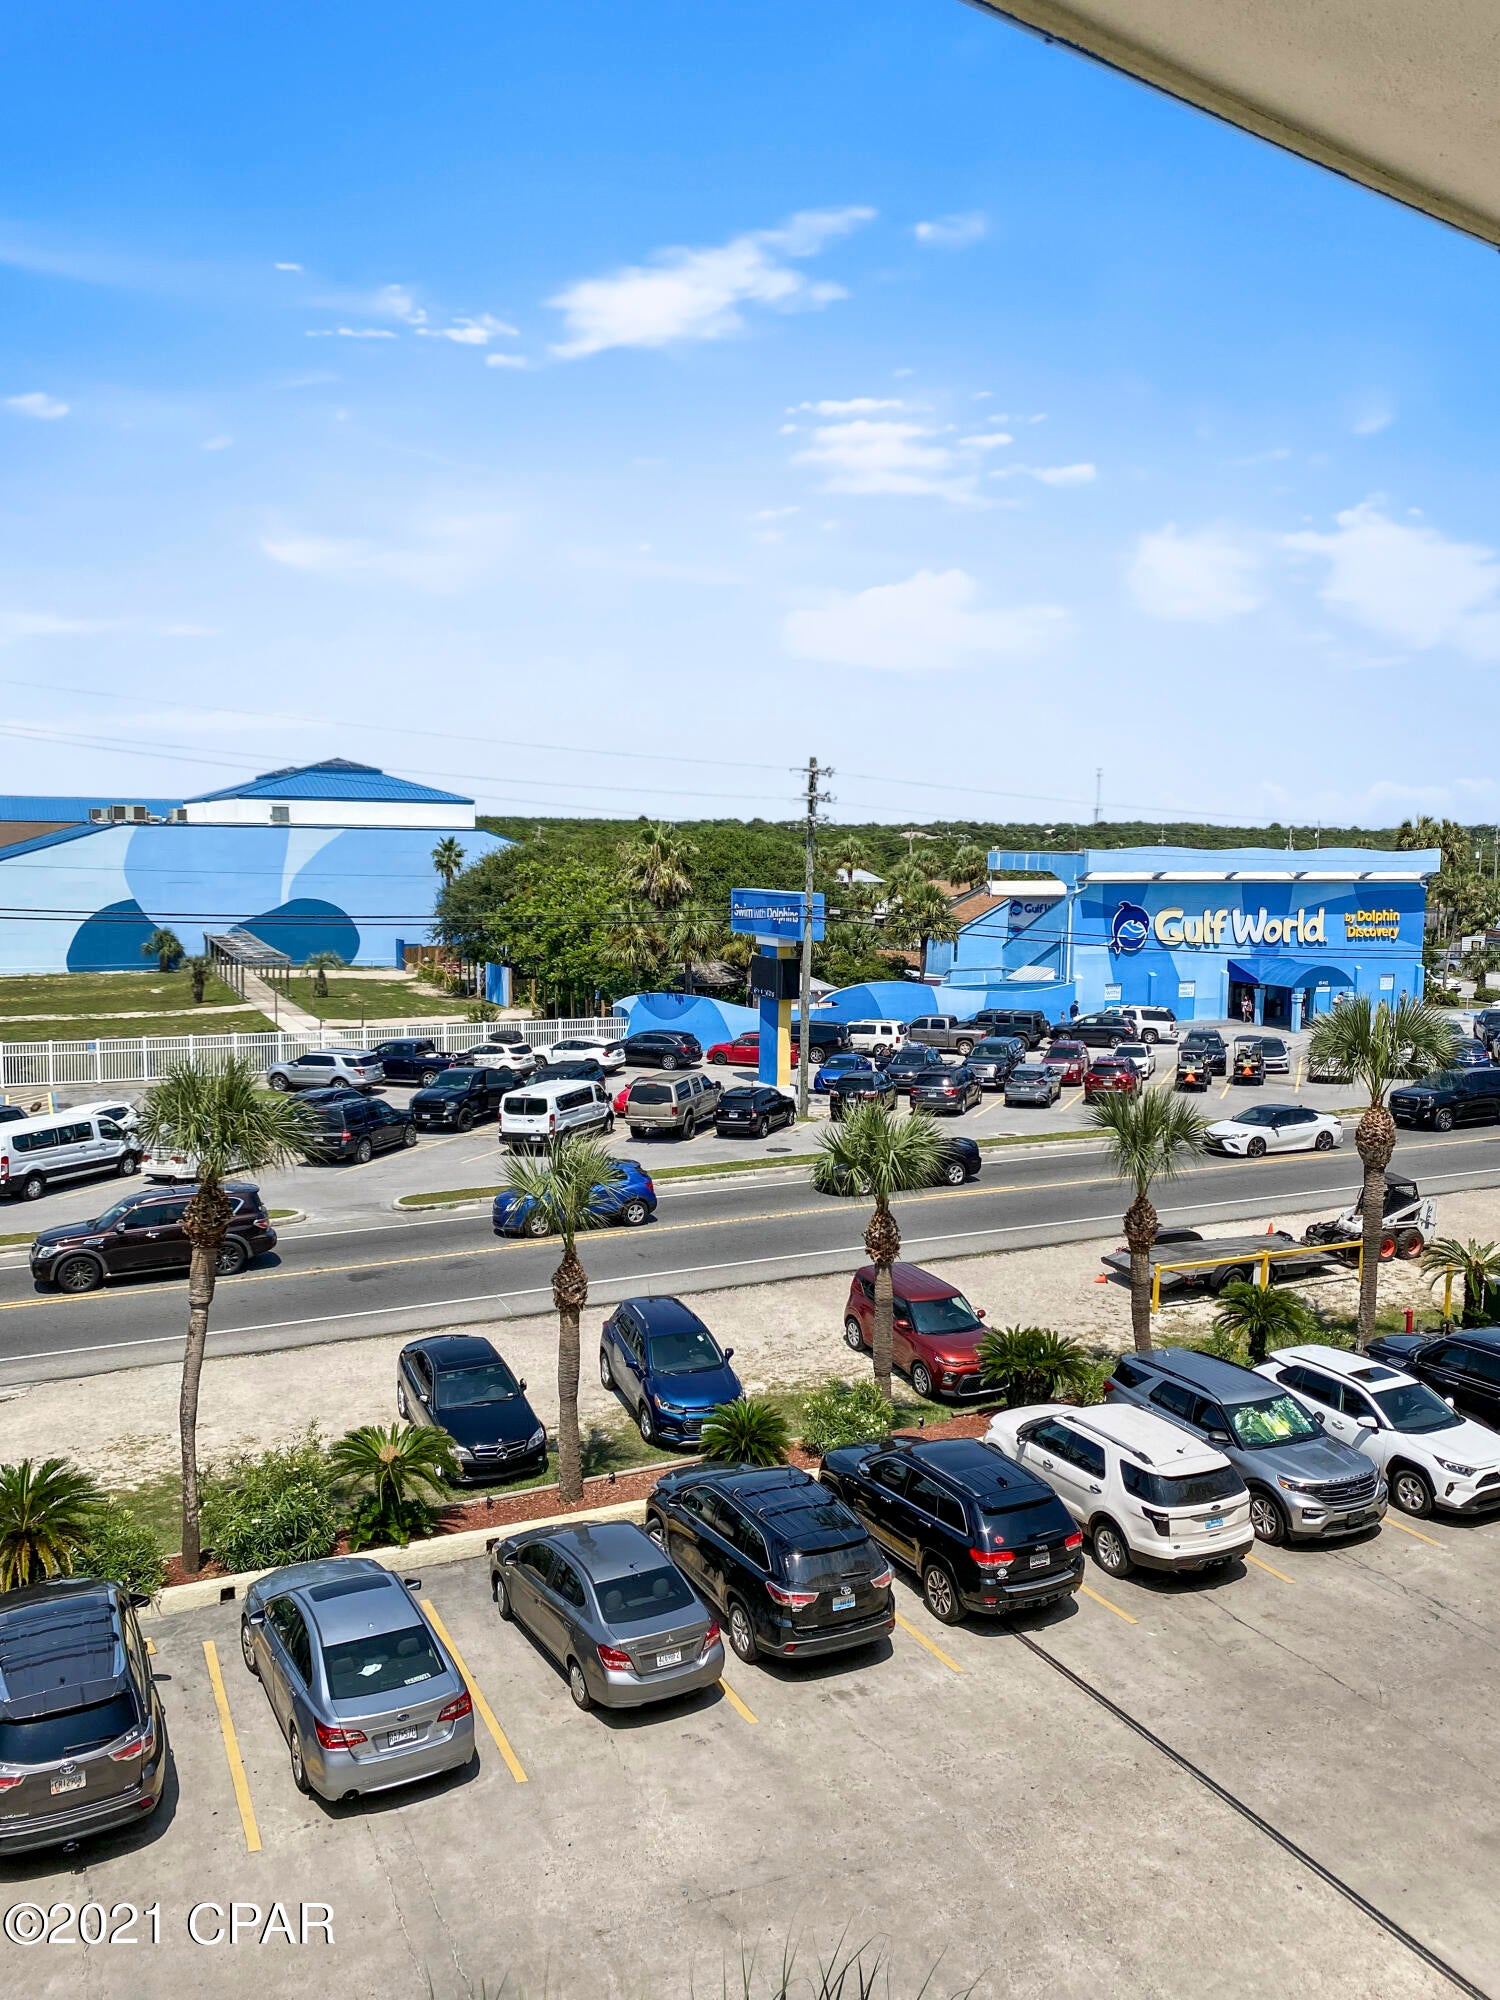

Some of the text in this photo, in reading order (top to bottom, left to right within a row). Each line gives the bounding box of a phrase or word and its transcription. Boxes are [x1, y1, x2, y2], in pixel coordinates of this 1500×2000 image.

[734, 903, 799, 924] Swim with Dolphins
[1344, 908, 1400, 924] by Dolphin
[1346, 925, 1400, 940] Discovery
